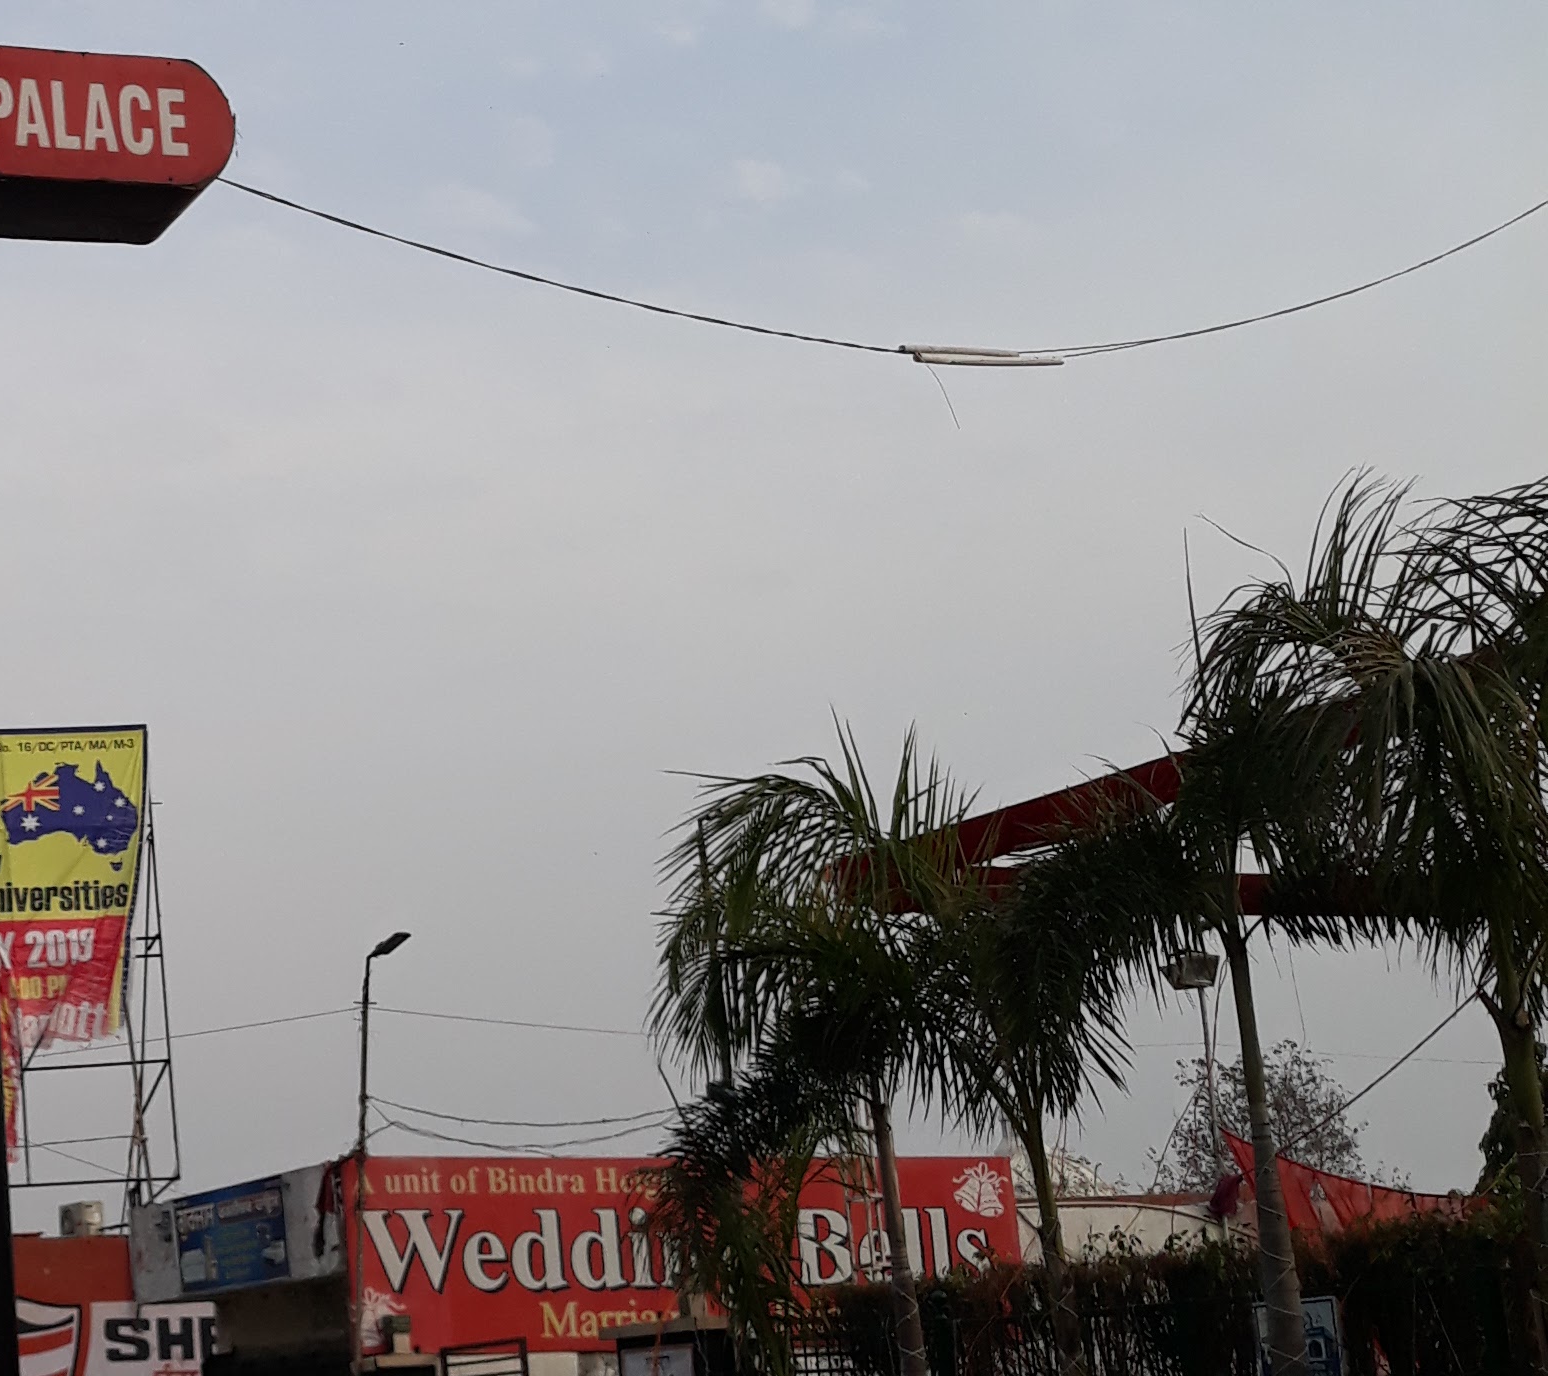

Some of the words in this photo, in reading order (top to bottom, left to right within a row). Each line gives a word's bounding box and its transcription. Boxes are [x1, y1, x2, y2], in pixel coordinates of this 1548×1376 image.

[384, 1167, 441, 1194] unit
[451, 1166, 480, 1195] of
[487, 1166, 586, 1195] Bindra
[361, 1207, 682, 1294] Weddi
[539, 1300, 679, 1339] Marri
